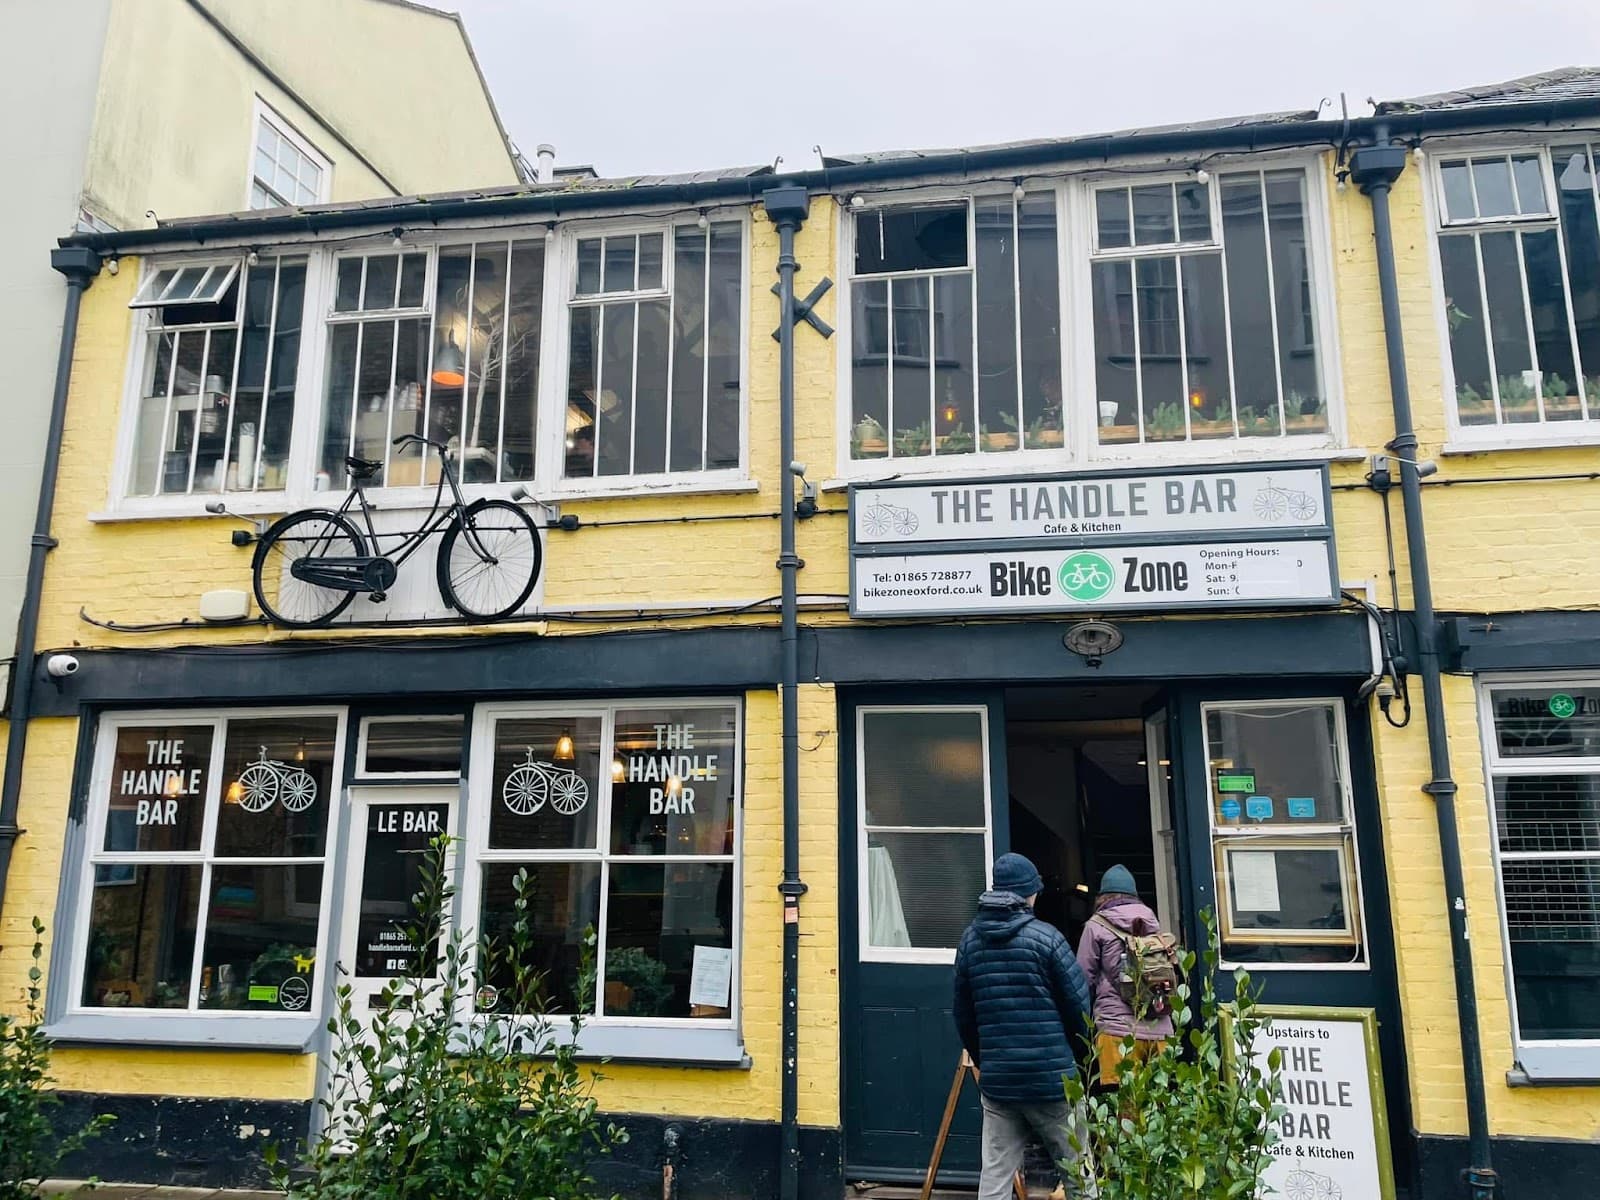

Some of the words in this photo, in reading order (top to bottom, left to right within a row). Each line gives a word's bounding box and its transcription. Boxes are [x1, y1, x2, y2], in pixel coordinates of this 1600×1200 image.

[931, 489, 994, 523] THE
[1010, 482, 1148, 521] HANDLE
[1165, 478, 1237, 515] BAR
[1044, 523, 1067, 534] Cafe
[1070, 523, 1079, 533] &
[1082, 522, 1121, 532] Kitchen
[1200, 549, 1244, 560] Opening
[1246, 548, 1280, 557] Hours:
[873, 573, 892, 582] Tel:
[894, 572, 928, 582] 01865
[931, 571, 971, 581] 728877
[990, 561, 1051, 597] Bike
[1123, 557, 1188, 593] Zone
[1206, 574, 1226, 583] Sat:
[863, 584, 983, 597] bikezoneoxford.co.uk
[1207, 587, 1230, 596] Sun:
[653, 724, 695, 750] THE
[146, 740, 184, 765] THE
[629, 755, 718, 782] HANDLE
[121, 769, 202, 795] HANDLE
[136, 800, 178, 825] BAR
[649, 787, 695, 815] BAR
[377, 811, 398, 832] LE
[402, 811, 439, 832] BAR
[1266, 1026, 1315, 1040] Upstairs
[1318, 1029, 1330, 1039] to
[1275, 1046, 1323, 1072] THE
[1262, 1078, 1352, 1107] ANDLE
[1281, 1112, 1331, 1140] BAR
[1264, 1144, 1292, 1156] Cafe
[1295, 1145, 1305, 1157] &
[1308, 1146, 1354, 1160] Kitchen
